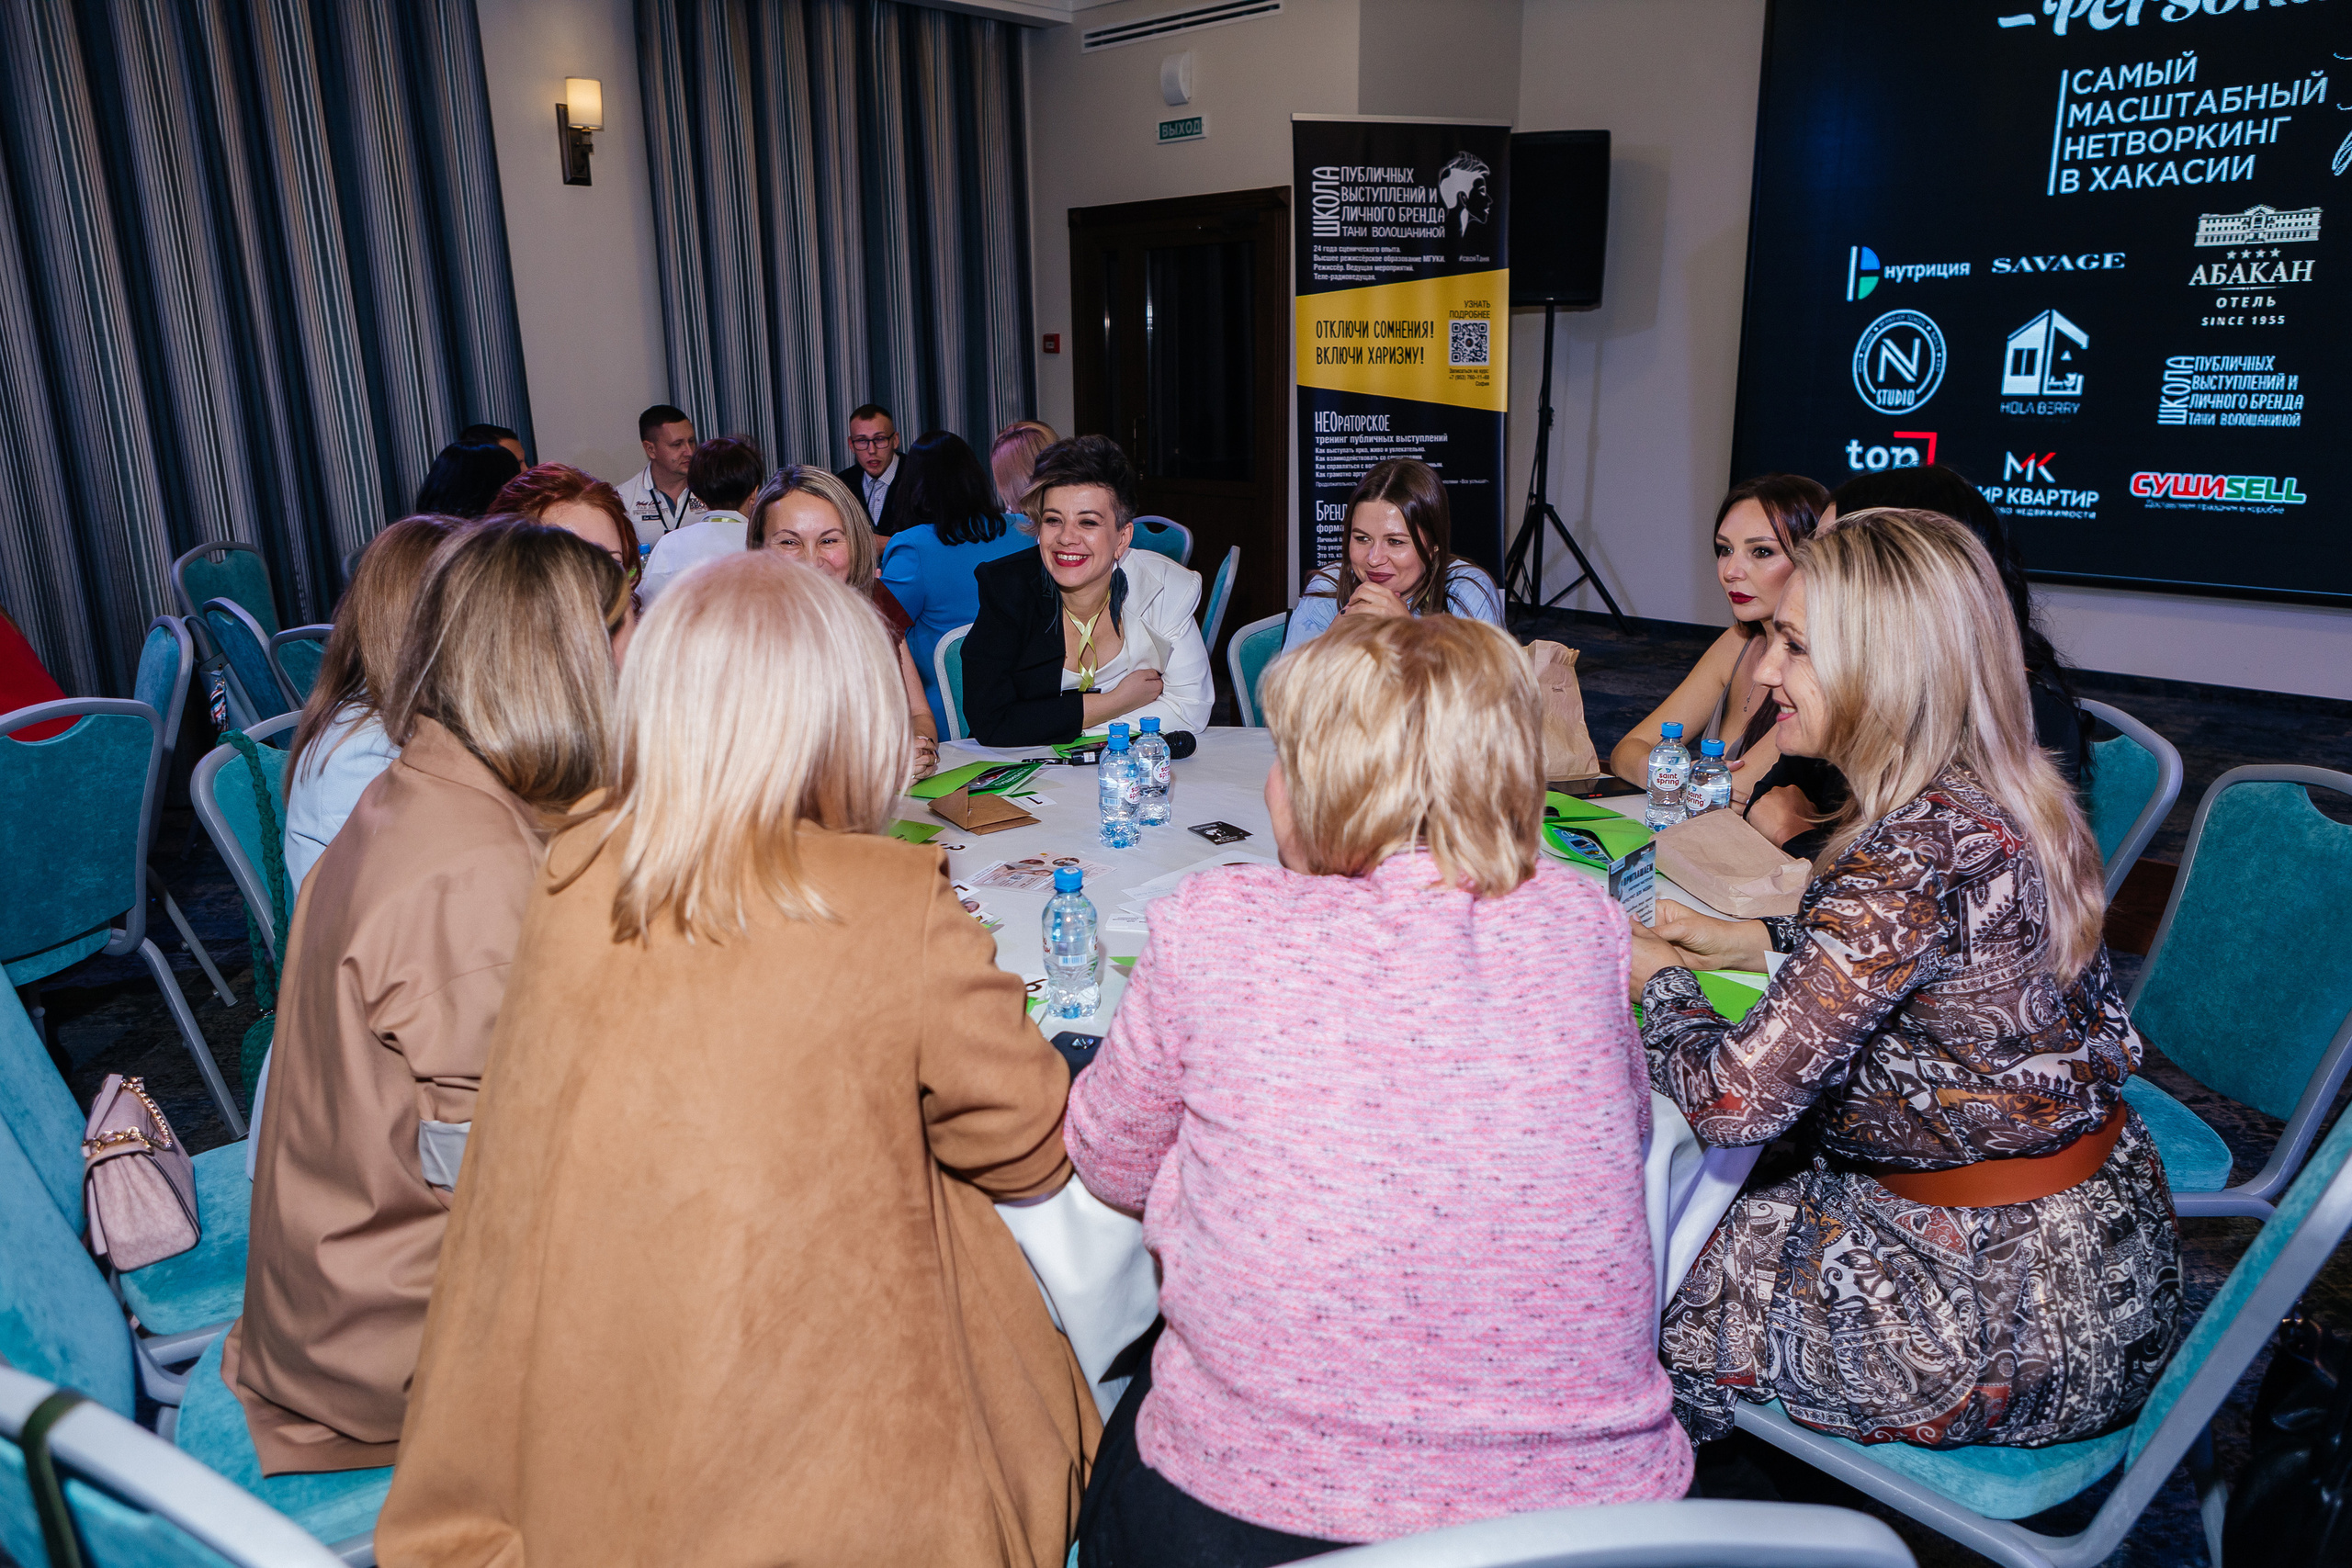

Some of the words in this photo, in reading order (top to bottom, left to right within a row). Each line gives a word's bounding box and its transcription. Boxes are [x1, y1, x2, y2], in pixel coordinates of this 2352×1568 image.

[2072, 50, 2198, 95] САМЫЙ
[2067, 70, 2329, 129] МАСШТАБНЫЙ
[1161, 119, 1202, 138] ВЫХОД
[2063, 116, 2292, 161] НЕТВОРКИНГ
[1341, 166, 1415, 184] ПУБЛИЧНЫХ
[2060, 169, 2080, 195] В
[2088, 154, 2256, 192] ХАКАСИИ
[1312, 166, 1340, 237] ШКОЛА
[1341, 186, 1426, 203] ВЫСТУПЛЕНИЙ
[1429, 187, 1438, 204] И
[1341, 206, 1396, 222] ЛИЧНОГО
[1398, 207, 1445, 224] БРЕНДА
[1341, 226, 1367, 237] ТАНИ
[1372, 225, 1445, 238] ВОЛОШАНИНОЙ
[1313, 254, 1339, 262] Высшее
[1339, 245, 1380, 254] сценического
[1346, 264, 1374, 272] Ведущая
[1884, 262, 1971, 283] нутриция
[1991, 253, 2126, 274] SAVAGE
[2188, 260, 2316, 286] АБАКАН
[1464, 300, 1491, 309] УЗНАТЬ
[2216, 296, 2277, 309] ОТЕЛЬ
[1449, 310, 1491, 319] ПОДРОБНЕЕ
[2201, 316, 2245, 326] SINCE
[2251, 315, 2286, 324] 1955
[1316, 320, 1369, 339] ОТКЛЮЧИ
[1374, 320, 1434, 339] СОМНЕНИЯ!
[1316, 346, 1363, 365] ВКЛЮЧИ
[1367, 346, 1424, 365] ХАРИЗМУ!
[2193, 355, 2276, 371] ПУБЛИЧНЫХ
[2157, 355, 2195, 425] ШКОЛА
[2191, 373, 2285, 390] ВЫСТУПЛЕНИЙ
[2288, 375, 2299, 390] И
[1876, 389, 1916, 406] STUDIO
[2188, 393, 2248, 410] ЛИЧНОГО
[2250, 394, 2304, 411] БРЕНДА
[2000, 401, 2035, 414] HOLA
[2037, 401, 2080, 414] BERRY
[2188, 412, 2216, 425] ТАНИ
[2220, 412, 2301, 427] ВОЛОШАНИНОЙ
[1315, 435, 1348, 446] тренинг
[1350, 434, 1394, 445] публичных
[1396, 433, 1448, 444] выступлений
[1977, 486, 2003, 503] ИР
[2007, 487, 2099, 508] КВАРТИР
